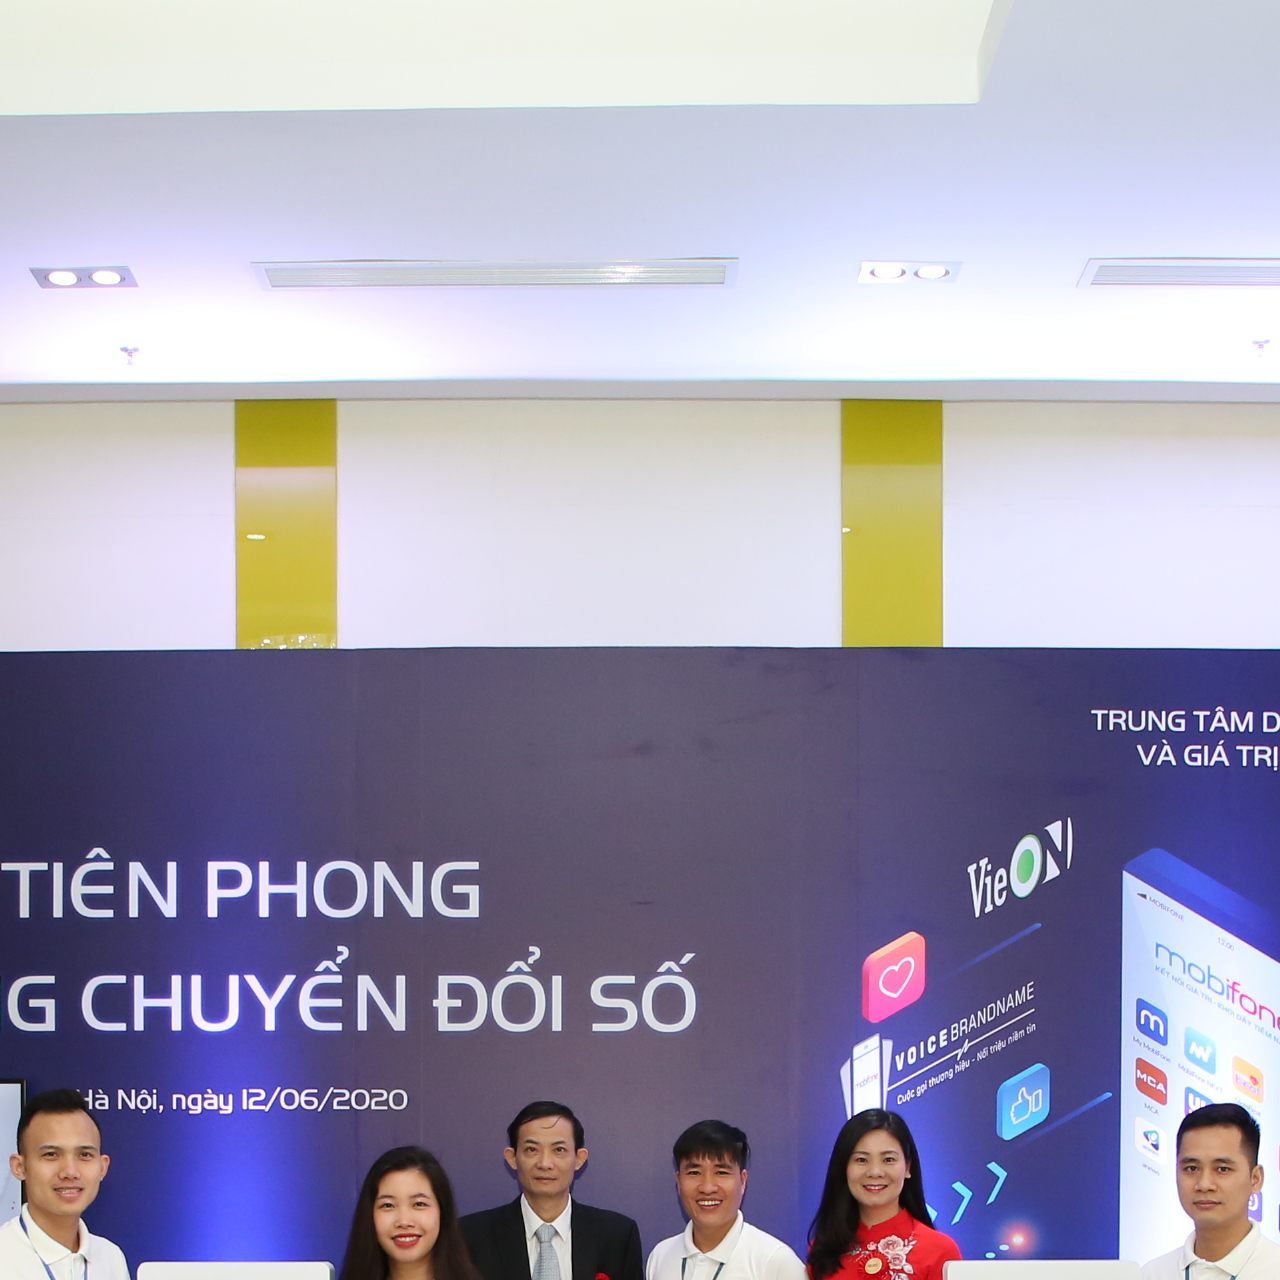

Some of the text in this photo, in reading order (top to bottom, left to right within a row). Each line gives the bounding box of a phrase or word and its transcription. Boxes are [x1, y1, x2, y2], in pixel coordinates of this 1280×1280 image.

[1091, 709, 1186, 733] TRUNG
[1193, 707, 1253, 733] TÂM
[1137, 739, 1176, 766] VÀ
[1184, 740, 1229, 767] GIÁ
[1236, 745, 1279, 771] TRỊ
[1, 847, 481, 919] TIÊN PHONG
[1149, 896, 1184, 922] MOBIFONE
[82, 945, 406, 1033] CHUYỂN
[433, 946, 562, 1033] ĐỔI
[592, 952, 696, 1033] SỐ
[895, 981, 1034, 1071] VOICE BRANDNAME
[897, 1090, 915, 1105] Cuộc
[916, 1083, 928, 1097] gọi
[955, 1059, 970, 1073] hiệu
[1026, 1023, 1036, 1034] tin
[1137, 1069, 1166, 1094] MCA
[77, 1087, 408, 1115] Hà Nội, ngày 12/06/2020
[1144, 1102, 1160, 1116] MCA
